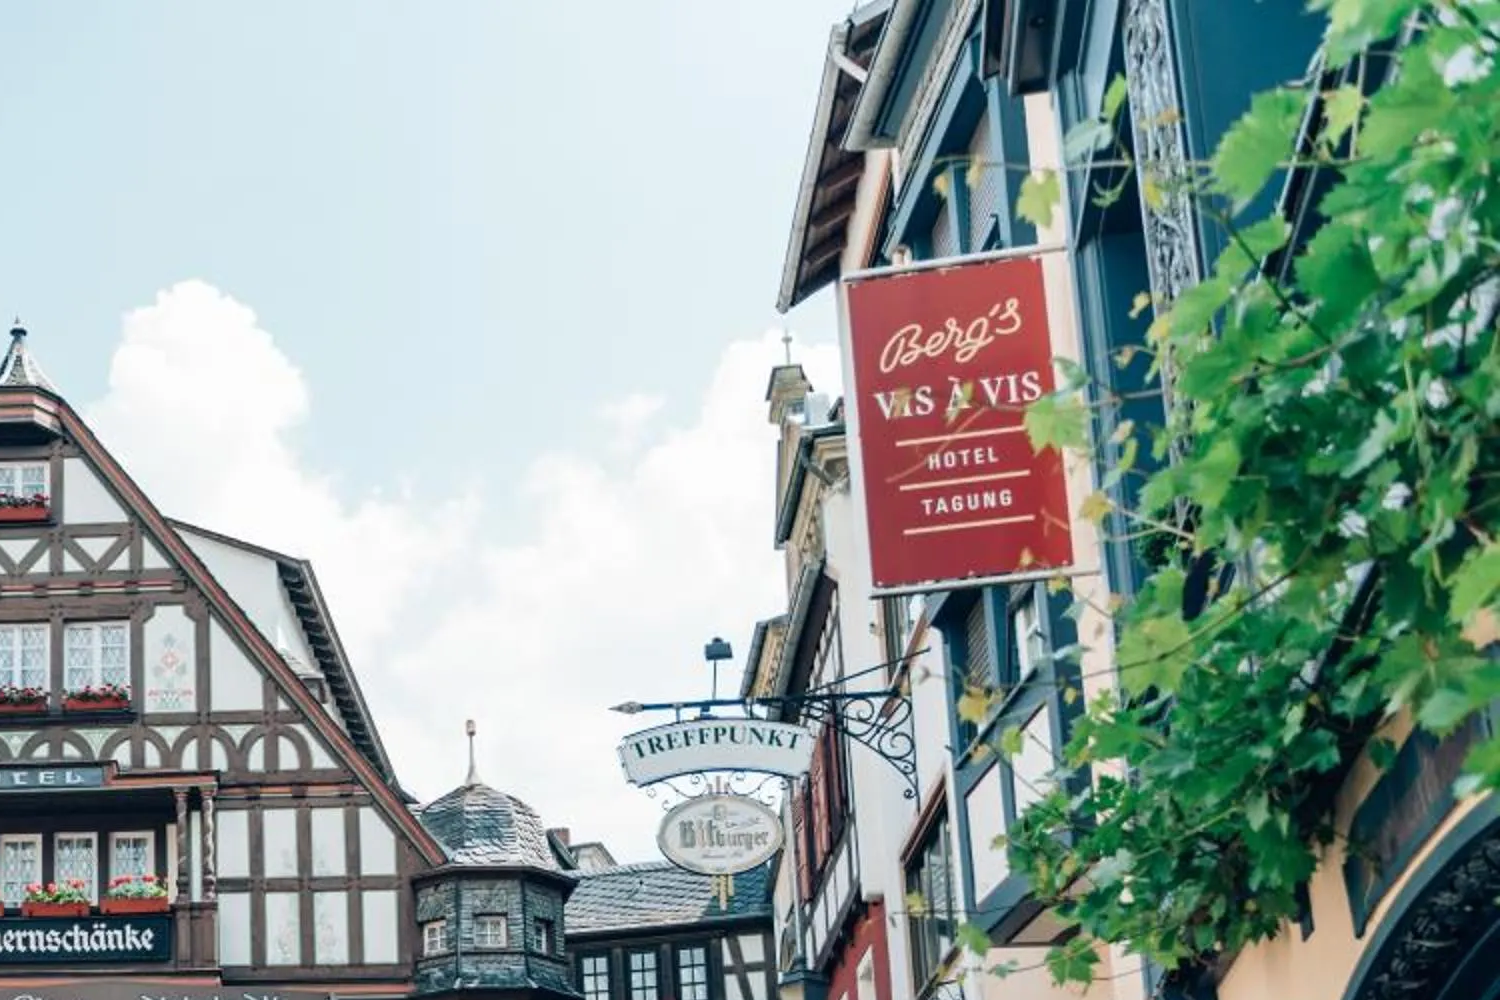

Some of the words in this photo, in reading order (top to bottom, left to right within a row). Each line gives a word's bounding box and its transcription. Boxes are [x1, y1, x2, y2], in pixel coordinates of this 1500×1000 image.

[879, 297, 1021, 373] Berg's
[873, 385, 935, 421] VIS
[979, 371, 1043, 407] VIS
[925, 446, 999, 471] HOTEL
[920, 488, 1012, 516] TAGUNG
[629, 725, 800, 759] TREFFPUNKT
[678, 818, 769, 850] Bitburger
